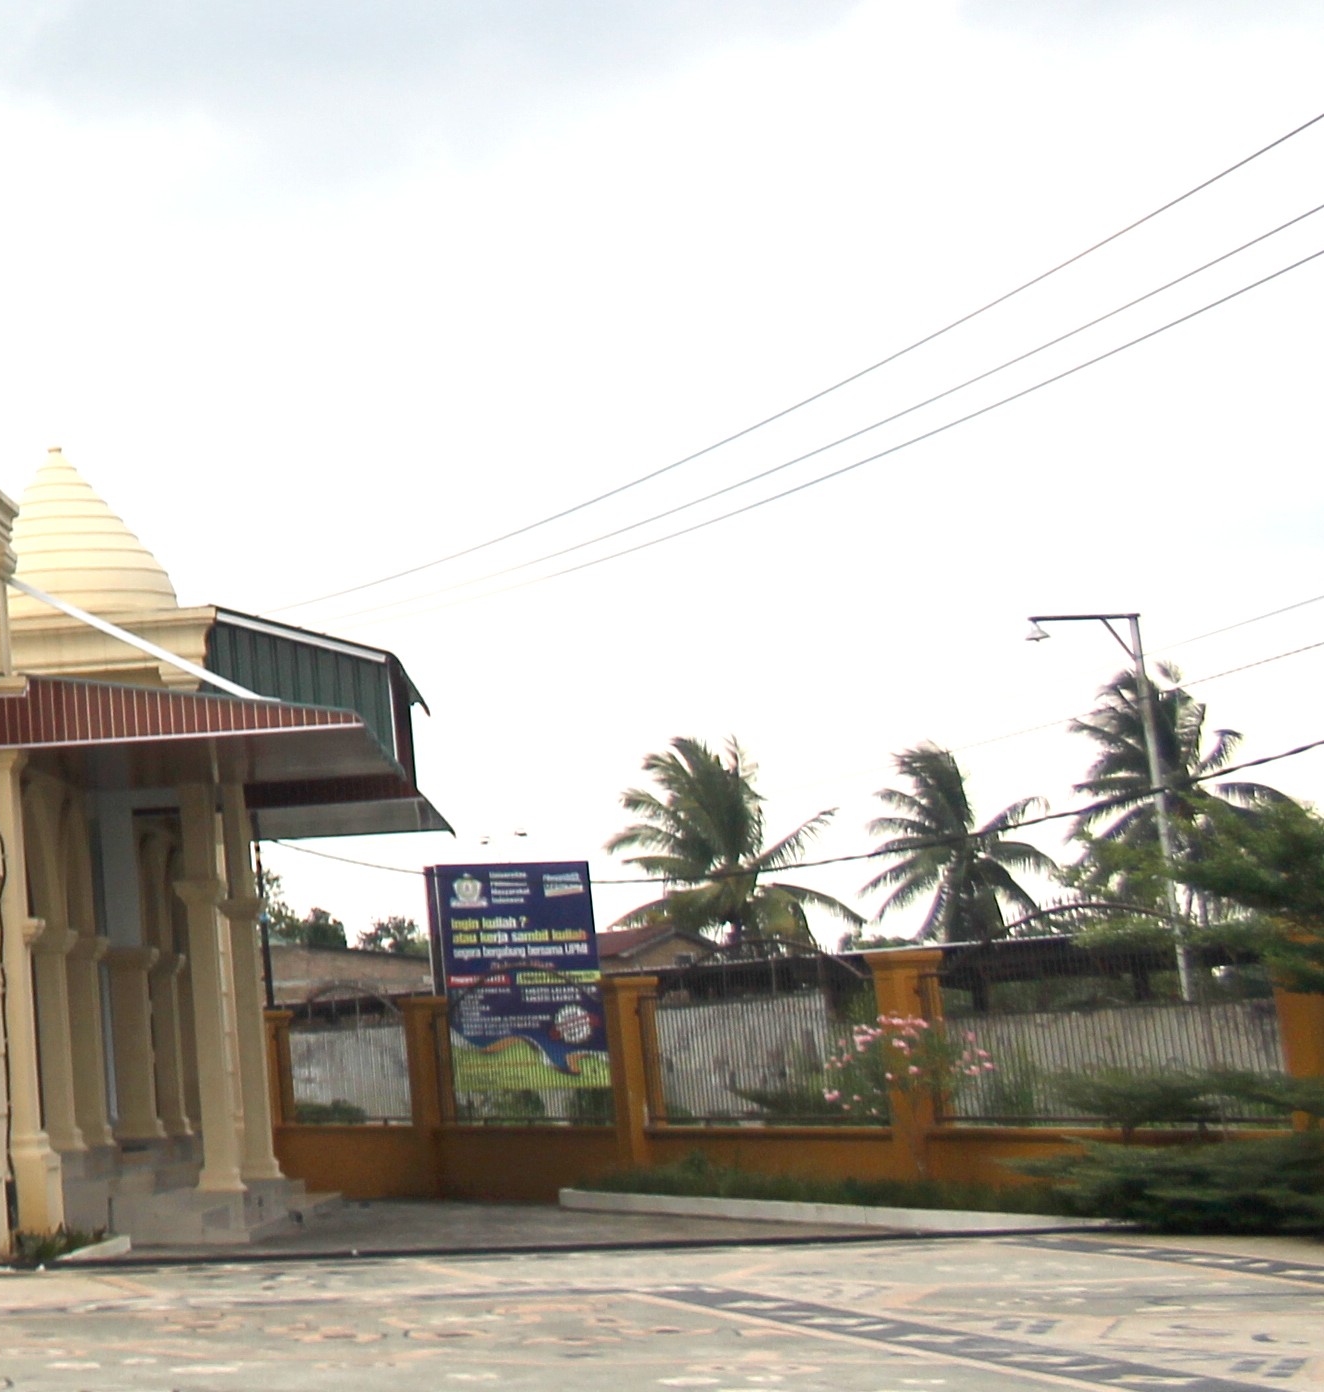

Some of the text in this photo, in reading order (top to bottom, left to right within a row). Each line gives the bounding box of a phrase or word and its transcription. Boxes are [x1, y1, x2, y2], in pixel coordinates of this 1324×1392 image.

[482, 916, 517, 929] kuliah
[453, 932, 477, 944] atau
[480, 930, 509, 944] kerja
[512, 928, 549, 943] sambil
